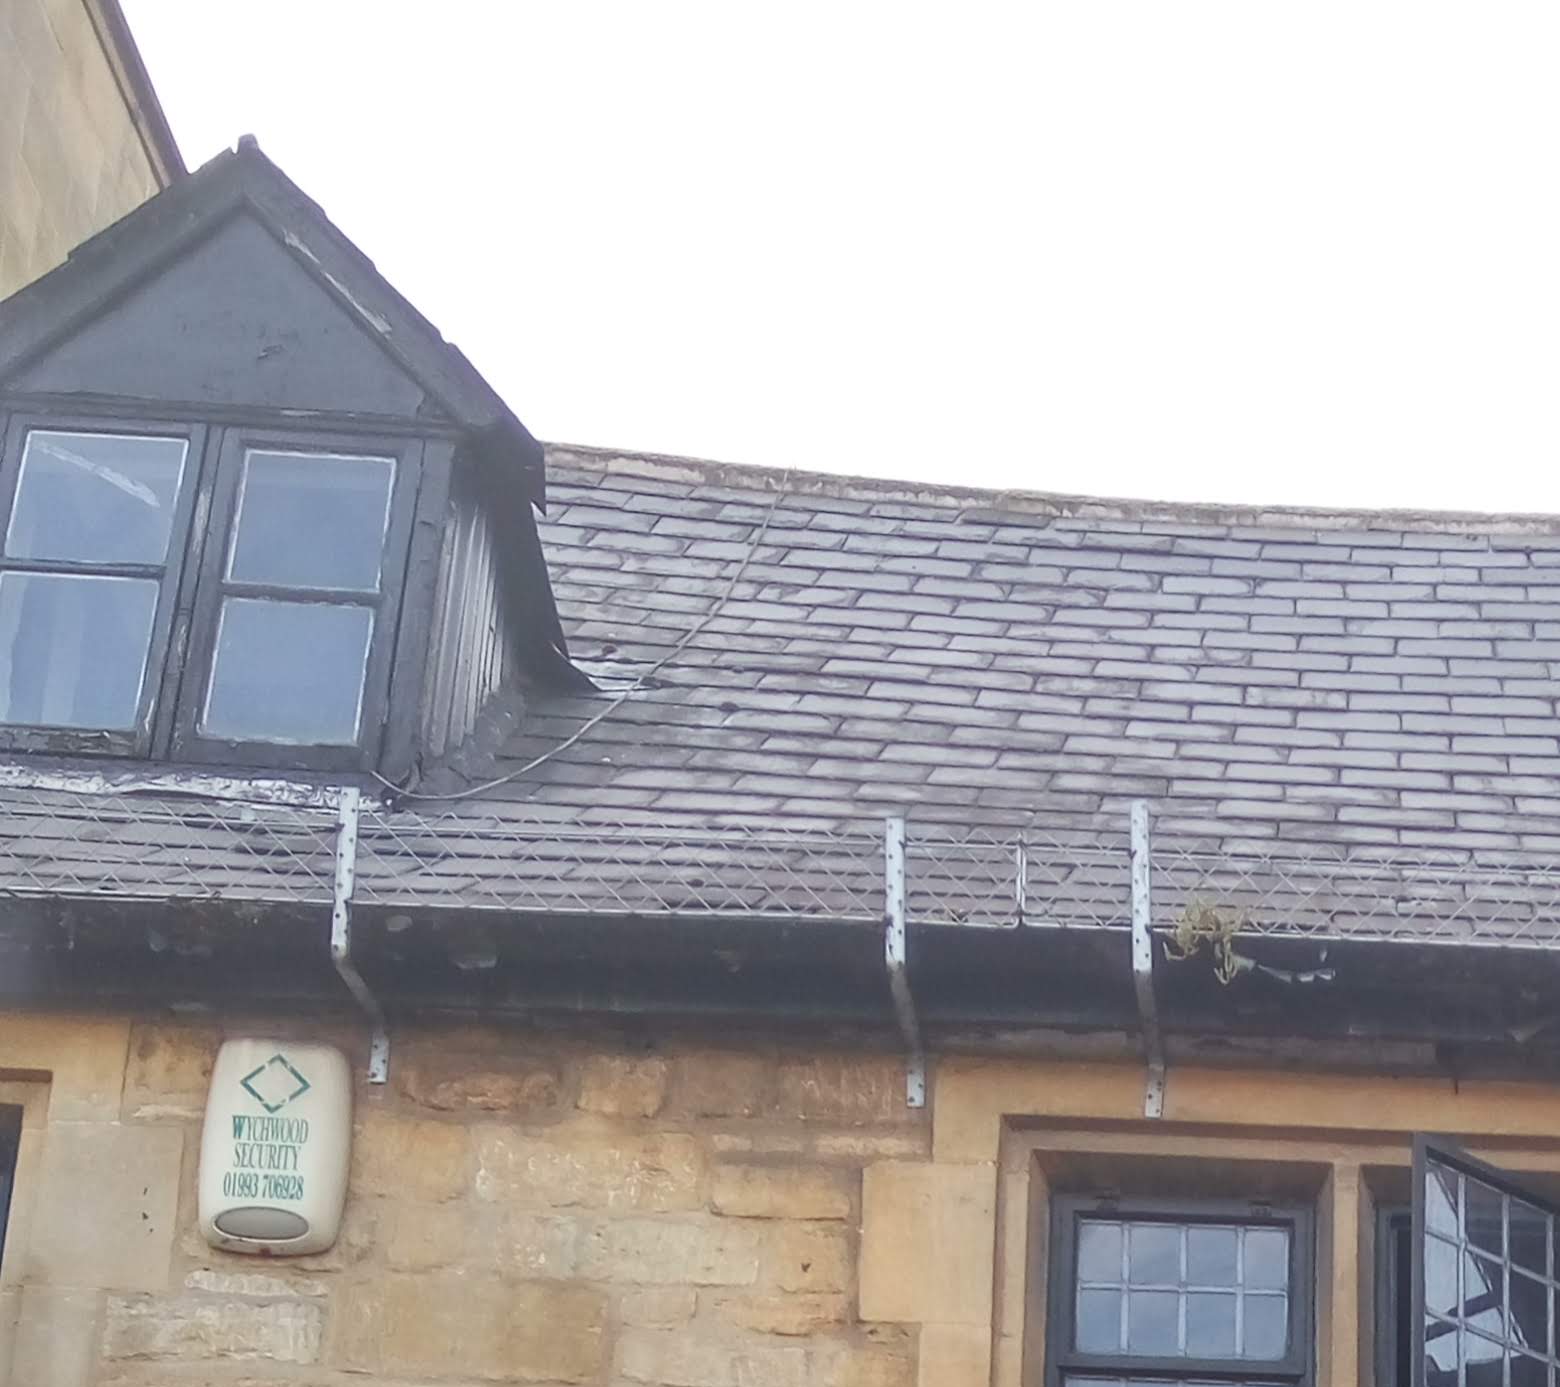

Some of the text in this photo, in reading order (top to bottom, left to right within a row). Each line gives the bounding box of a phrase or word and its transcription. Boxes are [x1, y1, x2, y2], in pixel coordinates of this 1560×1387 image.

[232, 1115, 309, 1144] WYCHWOOD
[232, 1143, 301, 1171] SECURITY
[223, 1171, 259, 1198] 01993
